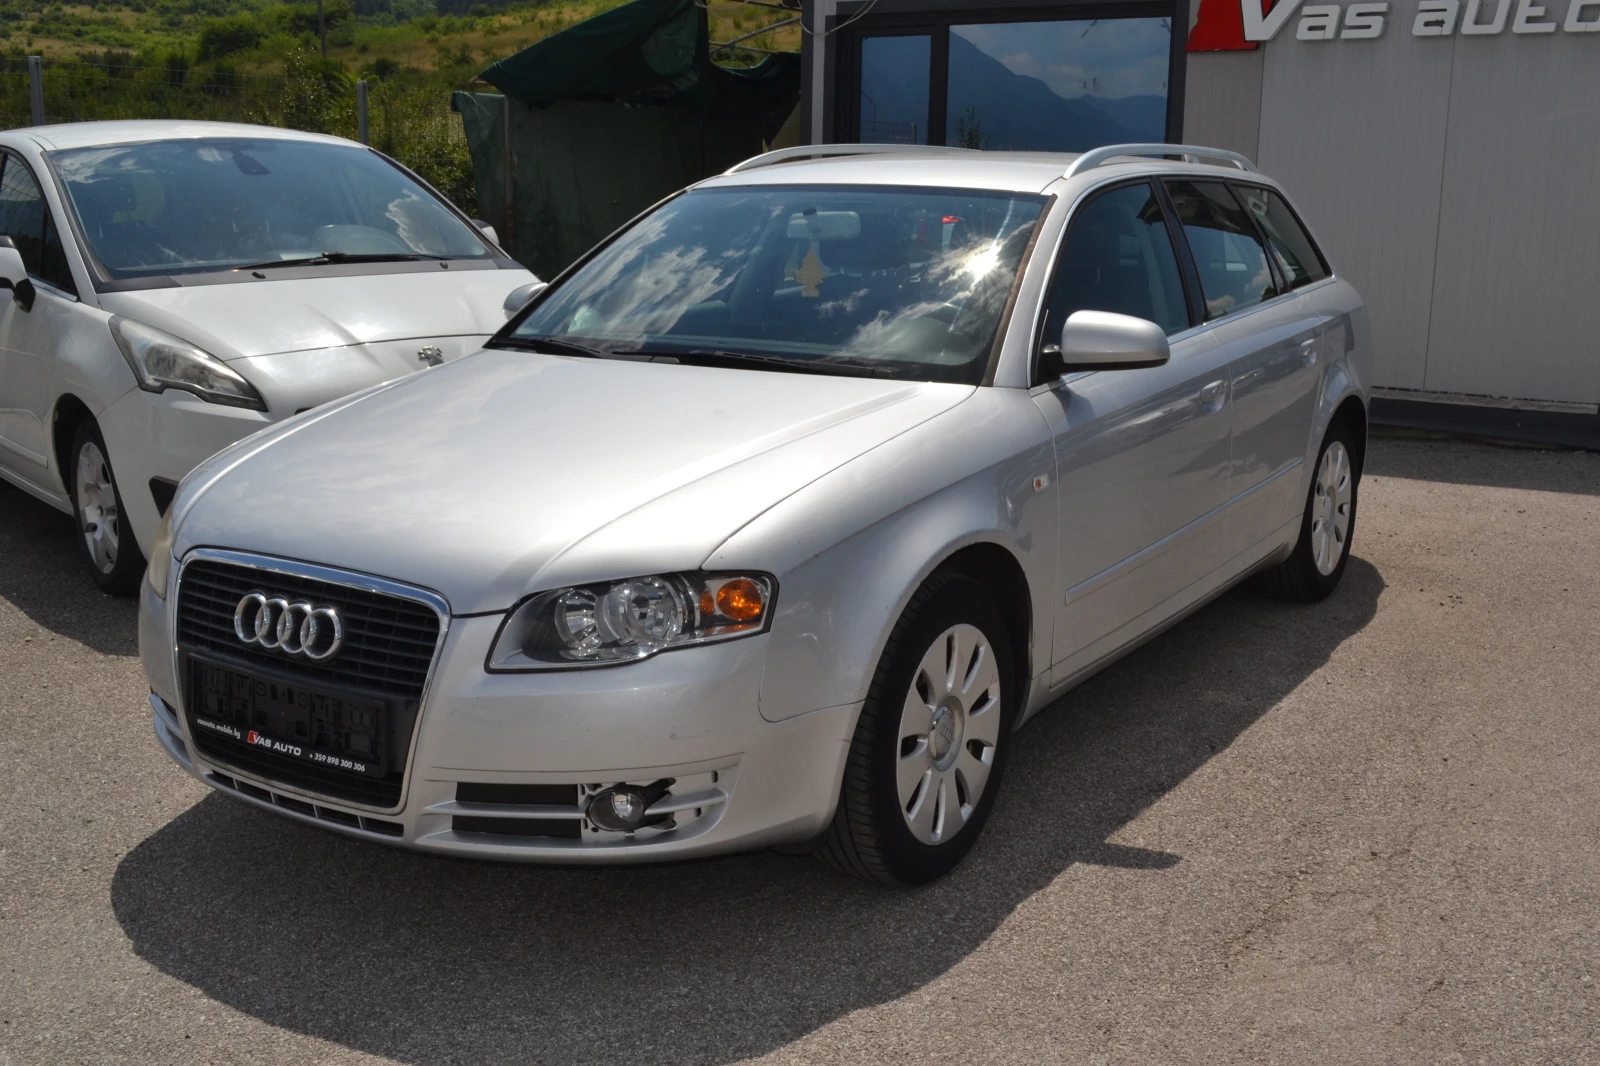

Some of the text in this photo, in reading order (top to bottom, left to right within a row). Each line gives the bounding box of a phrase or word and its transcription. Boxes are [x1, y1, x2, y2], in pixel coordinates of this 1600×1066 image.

[197, 718, 241, 740] vasauto.mobile.bg
[253, 733, 302, 756] VAS AUTO
[314, 753, 327, 762] 359
[326, 756, 340, 765] 898
[340, 759, 353, 769] 300
[353, 762, 366, 772] 306
